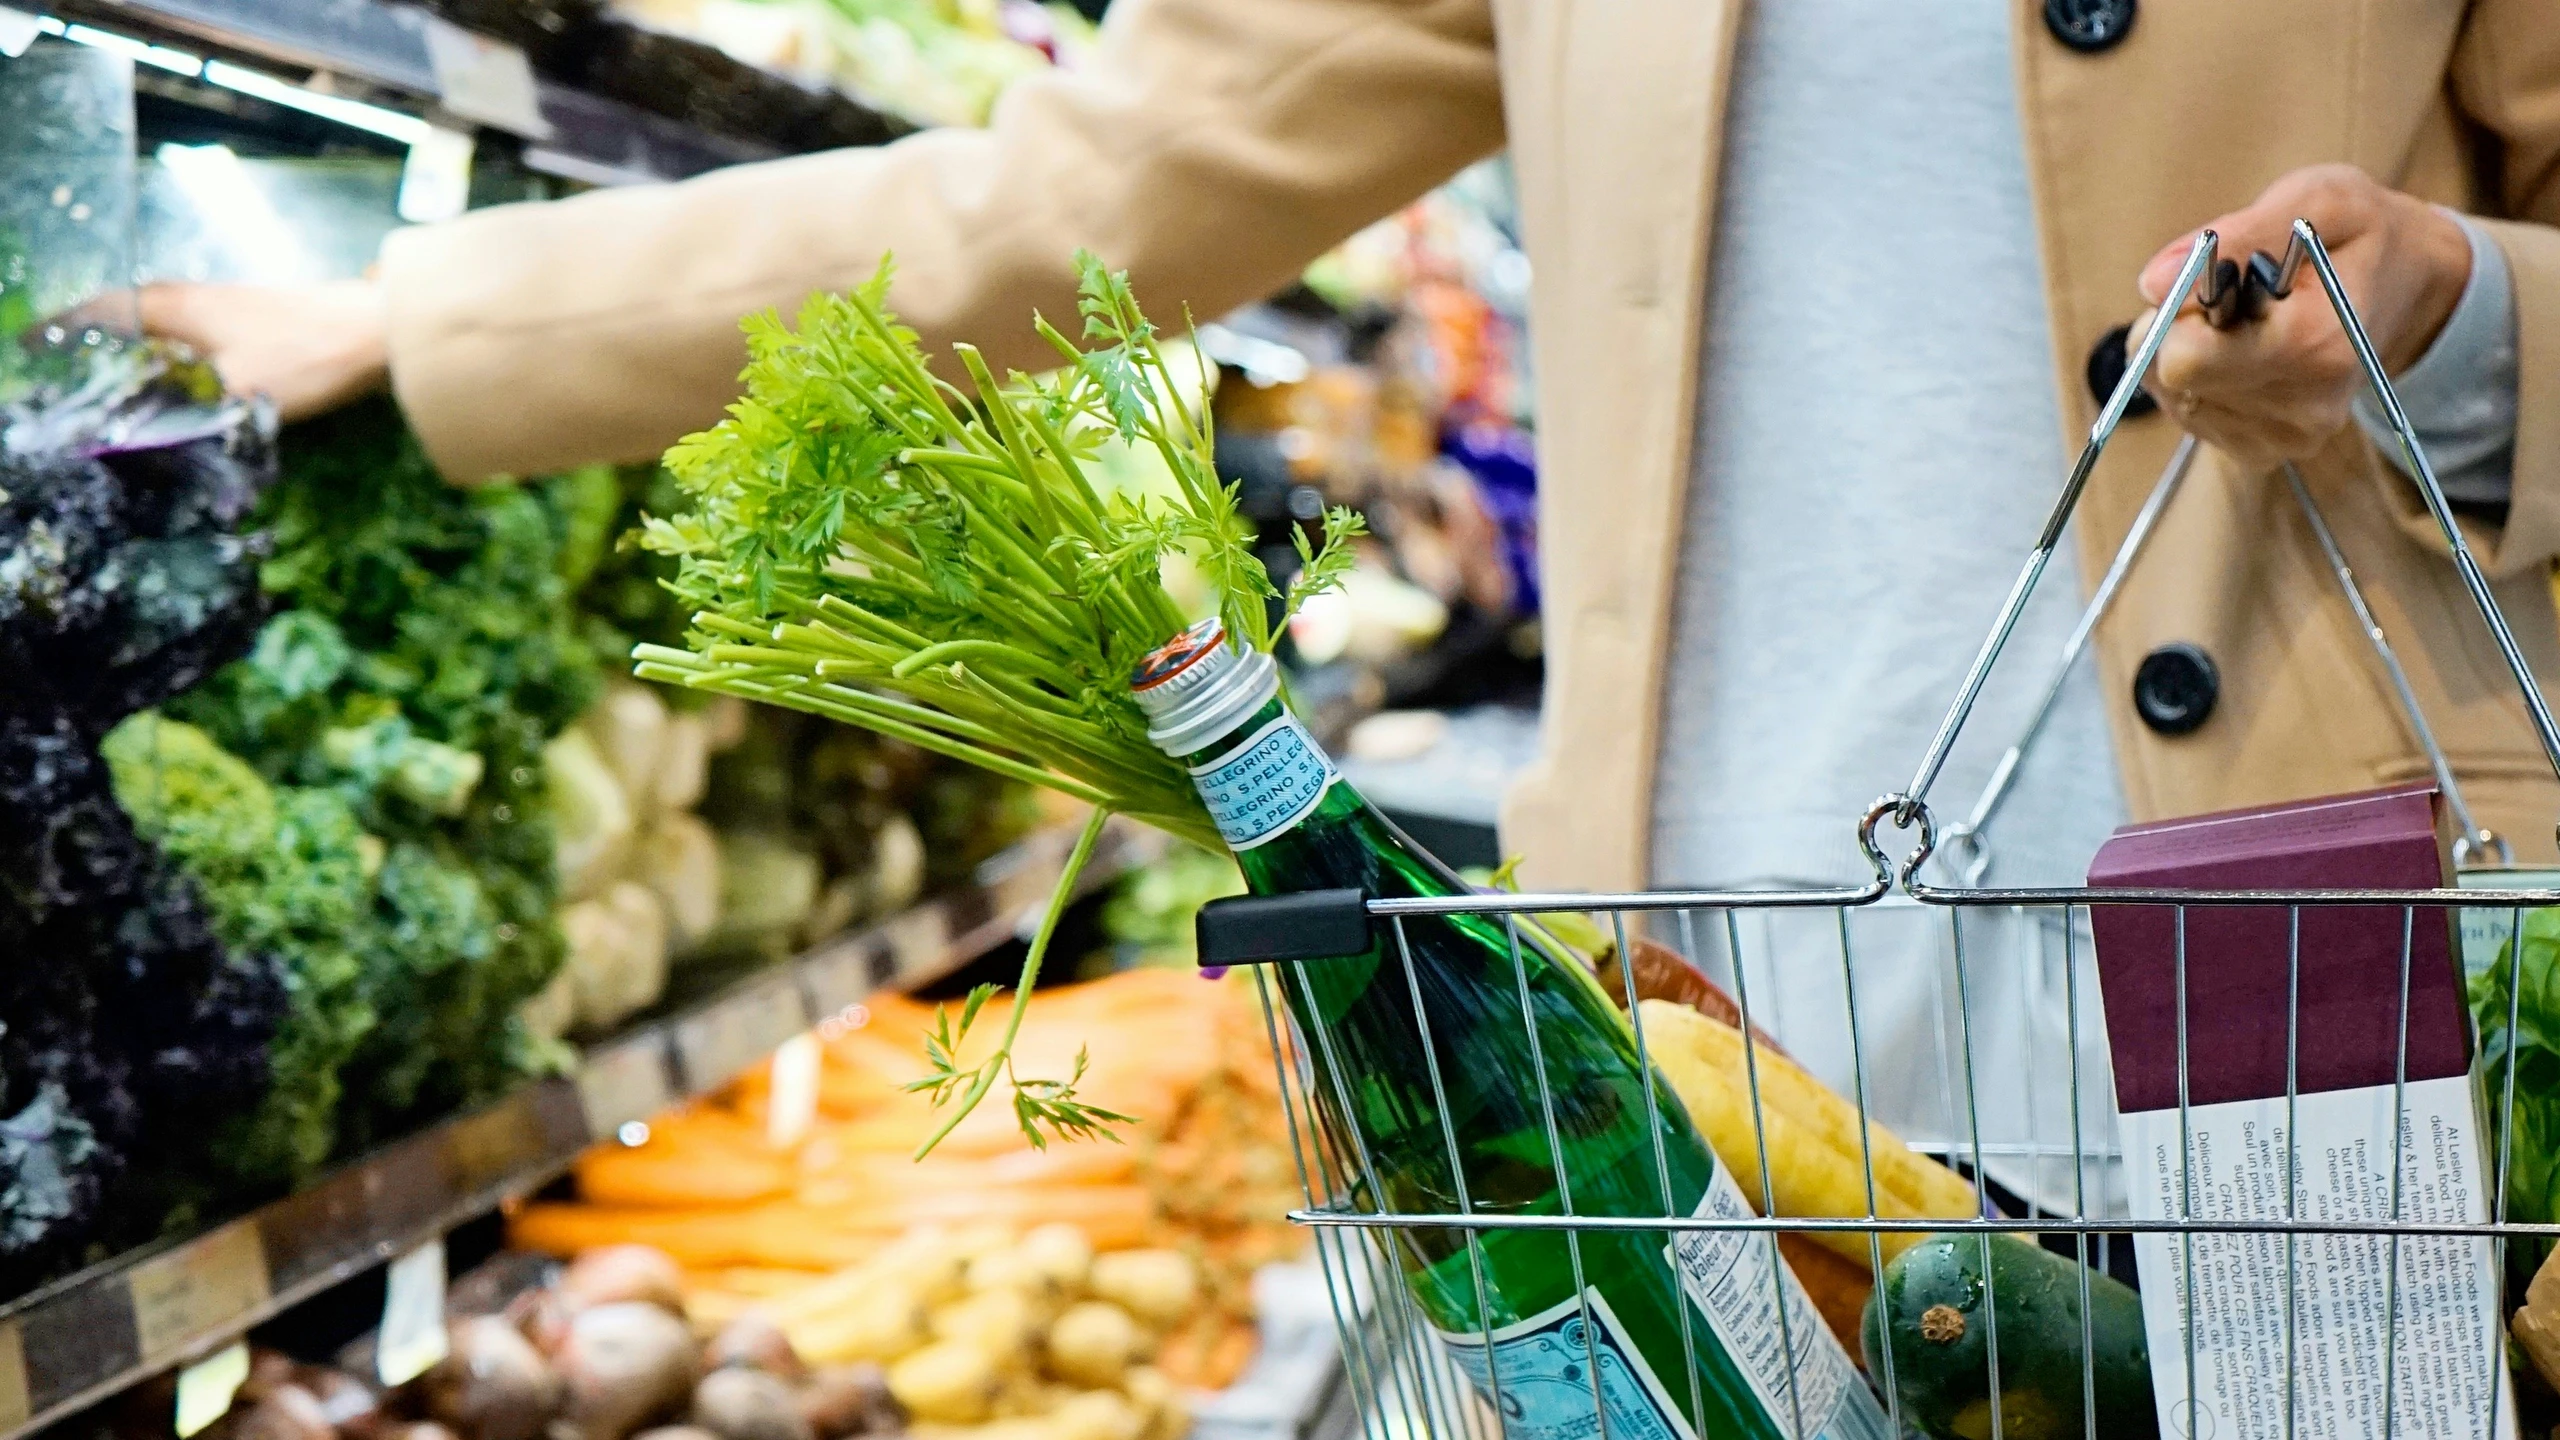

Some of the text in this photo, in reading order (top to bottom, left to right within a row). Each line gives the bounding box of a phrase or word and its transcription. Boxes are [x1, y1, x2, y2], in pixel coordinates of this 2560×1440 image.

[1203, 740, 1280, 789] ELLEGRINO
[2243, 1120, 2257, 1149] Seul
[2273, 1127, 2284, 1142] de
[2430, 1114, 2448, 1169] delicious
[2446, 1125, 2459, 1140] At
[2156, 1144, 2168, 1173] vous
[2197, 1131, 2215, 1188] Délicieux
[2247, 1152, 2256, 1167] un
[2260, 1139, 2271, 1168] avec
[2341, 1147, 2354, 1166] but
[2354, 1137, 2369, 1173] these
[2405, 1153, 2417, 1162] &
[2446, 1143, 2465, 1184] Lesley
[2160, 1176, 2170, 1192] ne
[2326, 1147, 2342, 1192] cheese
[2374, 1171, 2386, 1181] A
[2407, 1166, 2421, 1187] her
[2205, 1191, 2215, 1207] au
[2247, 1171, 2265, 1214] produit
[2264, 1171, 2278, 1201] soin,
[2340, 1169, 2359, 1203] really
[2356, 1176, 2375, 1218] unique
[2424, 1183, 2434, 1203] are
[2438, 1173, 2453, 1203] food.
[2268, 1205, 2278, 1221] en
[2296, 1189, 2310, 1219] Stow
[2317, 1194, 2328, 1221] snac
[2332, 1196, 2341, 1209] or
[2410, 1191, 2425, 1222] team
[2256, 1218, 2271, 1262] aison
[2442, 1206, 2458, 1245] The
[2198, 1244, 2209, 1260] de
[2240, 1233, 2258, 1277] pouvait
[2272, 1233, 2287, 1265] etites
[2331, 1212, 2352, 1272] apasto.
[2366, 1233, 2382, 1276] ackers
[2416, 1233, 2430, 1256] ink
[1689, 1242, 1721, 1281] Valeur
[2167, 1246, 2183, 1272] plus
[2214, 1260, 2225, 1281] ces
[2326, 1264, 2338, 1272] &
[2353, 1243, 2368, 1276] when
[2402, 1244, 2418, 1288] scratch
[2419, 1260, 2433, 1279] the
[2432, 1245, 2446, 1271] with
[2228, 1254, 2244, 1295] POUR
[2305, 1262, 2320, 1299] Foods
[2328, 1277, 2338, 1297] are
[2343, 1275, 2355, 1295] We
[2372, 1278, 2382, 1298] are
[2436, 1274, 2447, 1301] care
[2447, 1248, 2465, 1301] fabulous
[2464, 1261, 2480, 1300] Foods
[2173, 1275, 2185, 1304] vous
[2198, 1263, 2218, 1326] trempette,
[2260, 1266, 2278, 1316] fabriqué
[2354, 1280, 2374, 1322] topped
[2419, 1282, 2436, 1308] only
[2216, 1285, 2236, 1348] craquelins
[2234, 1297, 2249, 1327] CES
[2250, 1281, 2266, 1336] satisfaire
[2294, 1288, 2310, 1339] fabuleux
[2310, 1302, 2325, 1338] adore
[2331, 1301, 2342, 1327] sure
[2346, 1299, 2355, 1319] are
[2406, 1291, 2423, 1325] using
[2440, 1305, 2452, 1316] in
[2452, 1304, 2471, 1341] crisps
[2469, 1304, 2479, 1322] we
[2193, 1319, 2206, 1353] nous,
[2209, 1328, 2220, 1345] de
[2269, 1319, 2279, 1348] avec
[2364, 1325, 2378, 1350] with
[2413, 1328, 2423, 1347] our
[2423, 1312, 2437, 1337] way
[2442, 1320, 2457, 1353] small
[2472, 1326, 2486, 1351] love
[2238, 1329, 2253, 1362] FINS
[2333, 1332, 2345, 1354] you
[2349, 1322, 2365, 1375] addicted
[2430, 1340, 2442, 1352] to
[2226, 1351, 2240, 1377] sont
[2254, 1340, 2271, 1380] Lesley
[2273, 1351, 2286, 1374] des
[2312, 1342, 2333, 1395] fabriquer
[2338, 1357, 2351, 1376] will
[2364, 1354, 2378, 1380] your
[2416, 1351, 2431, 1385] finest
[2431, 1354, 2447, 1389] make
[2460, 1344, 2475, 1372] from
[2209, 1348, 2227, 1399] fromage
[2263, 1382, 2273, 1394] et
[2298, 1343, 2319, 1406] craquelins
[2341, 1380, 2354, 1395] be
[2356, 1378, 2367, 1390] to
[2447, 1356, 2464, 1409] batches.
[2473, 1354, 2493, 1400] making
[2218, 1402, 2228, 1418] ou
[2265, 1398, 2274, 1420] son
[2323, 1399, 2335, 1411] et
[2358, 1394, 2371, 1415] this
[2436, 1393, 2445, 1401] a
[2461, 1376, 2482, 1426] Lesley's
[2310, 1410, 2323, 1436] sont
[2435, 1404, 2453, 1436] great
